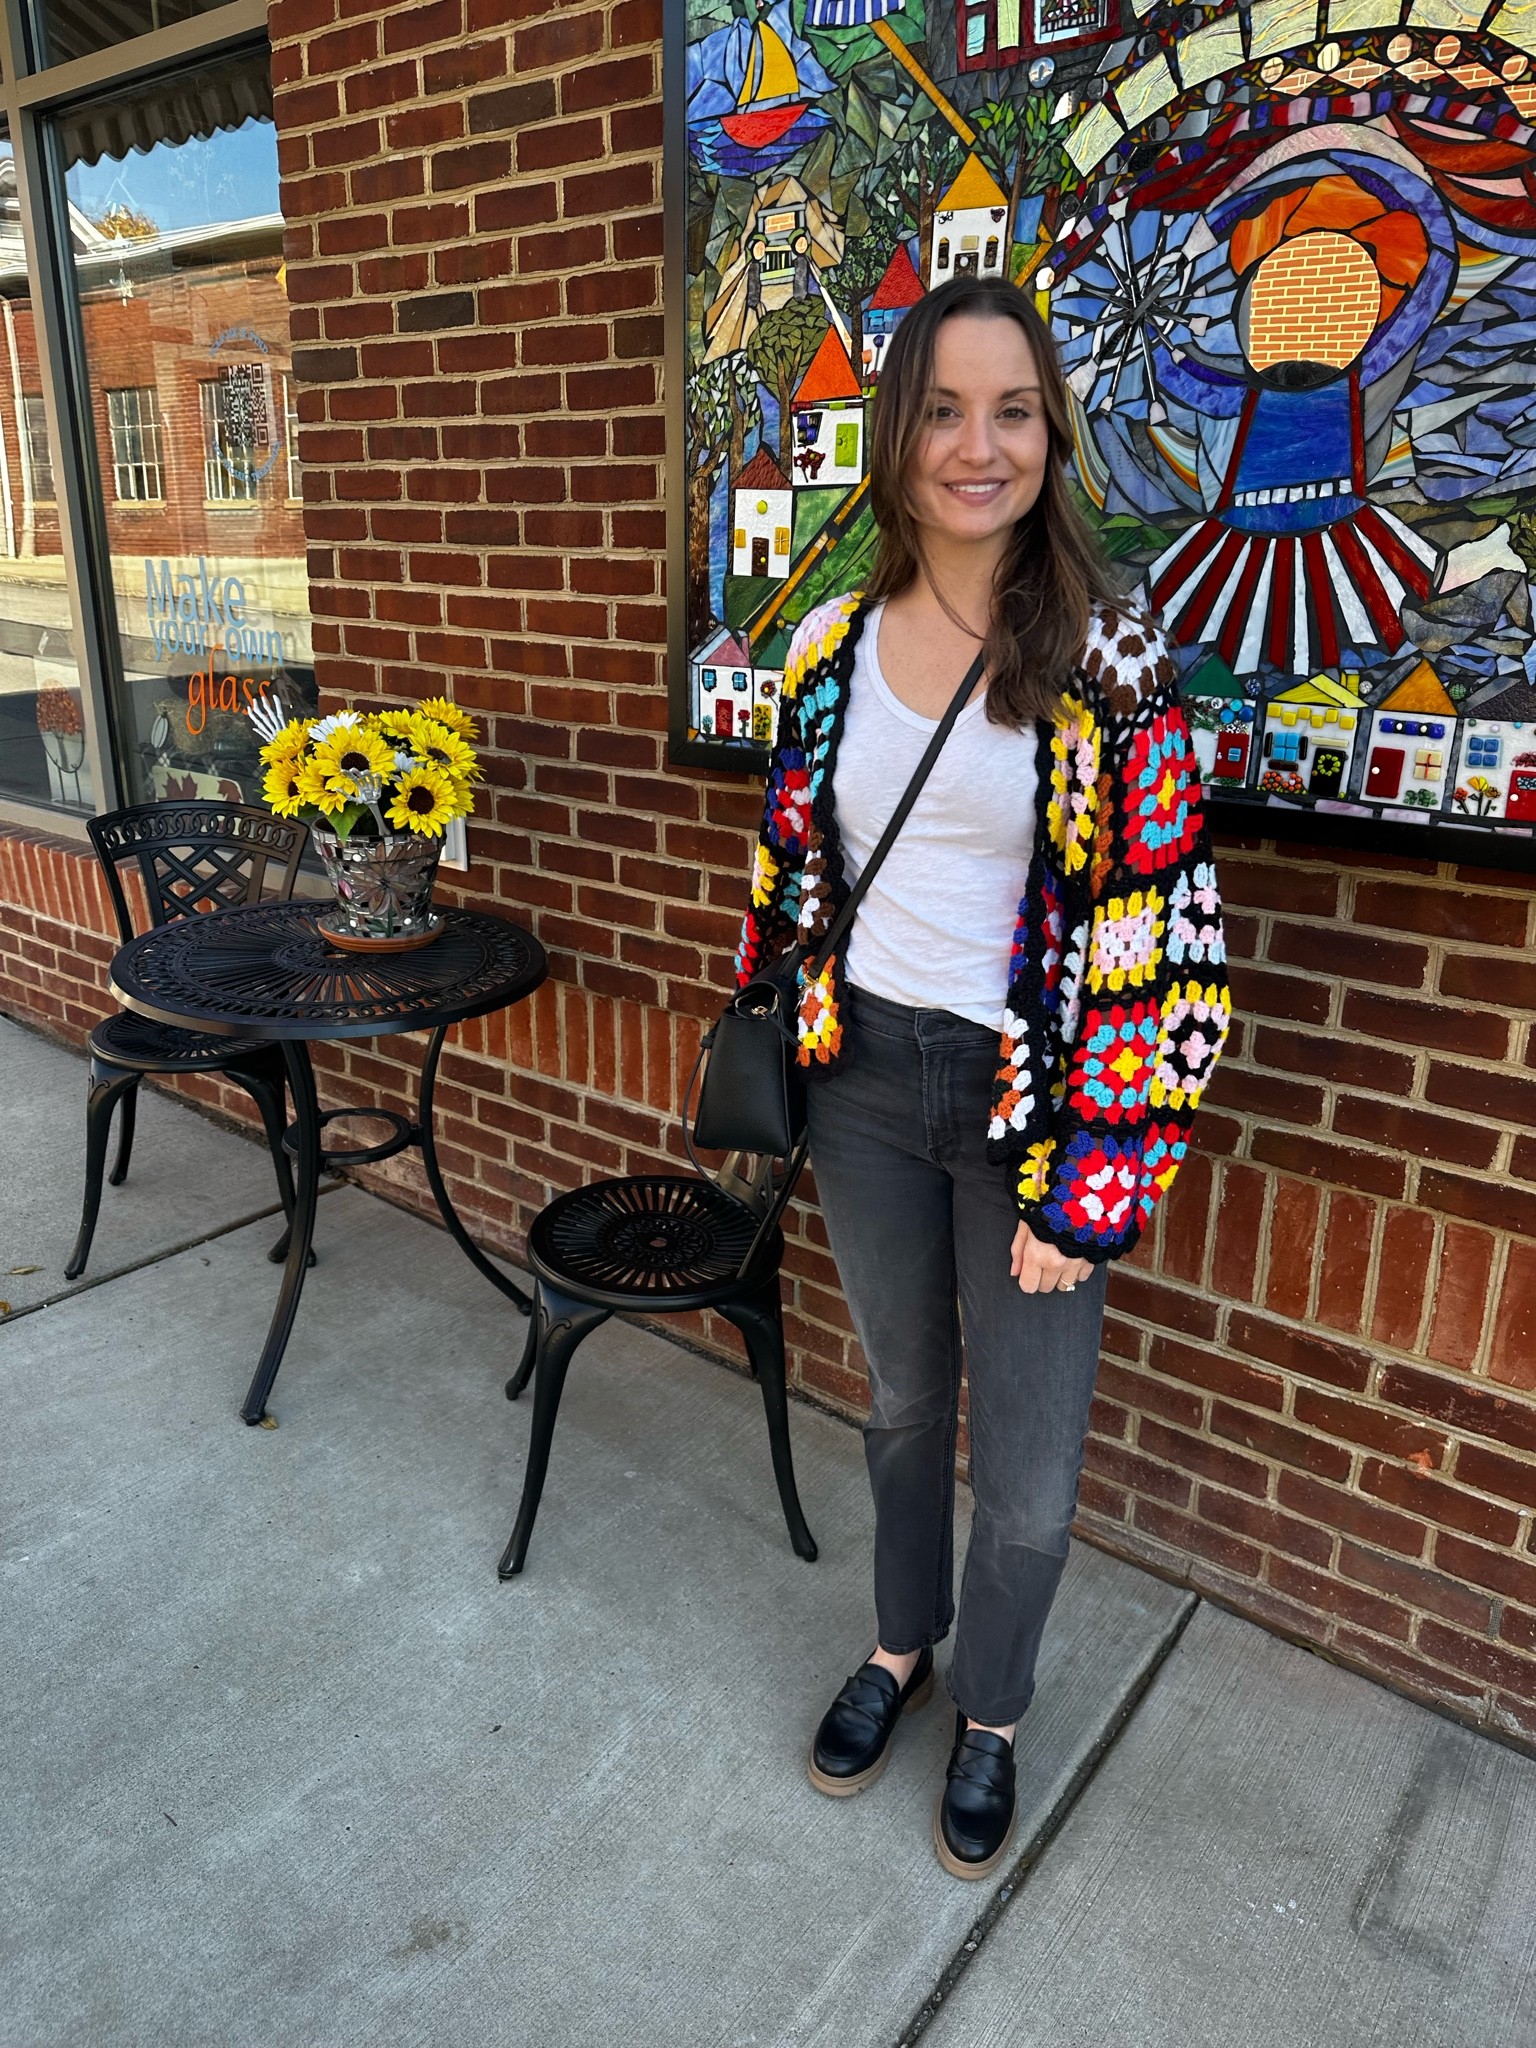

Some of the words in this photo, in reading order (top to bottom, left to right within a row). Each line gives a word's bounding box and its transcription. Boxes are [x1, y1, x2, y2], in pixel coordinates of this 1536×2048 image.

[145, 557, 246, 628] Make
[150, 620, 207, 662] your
[225, 627, 284, 667] own
